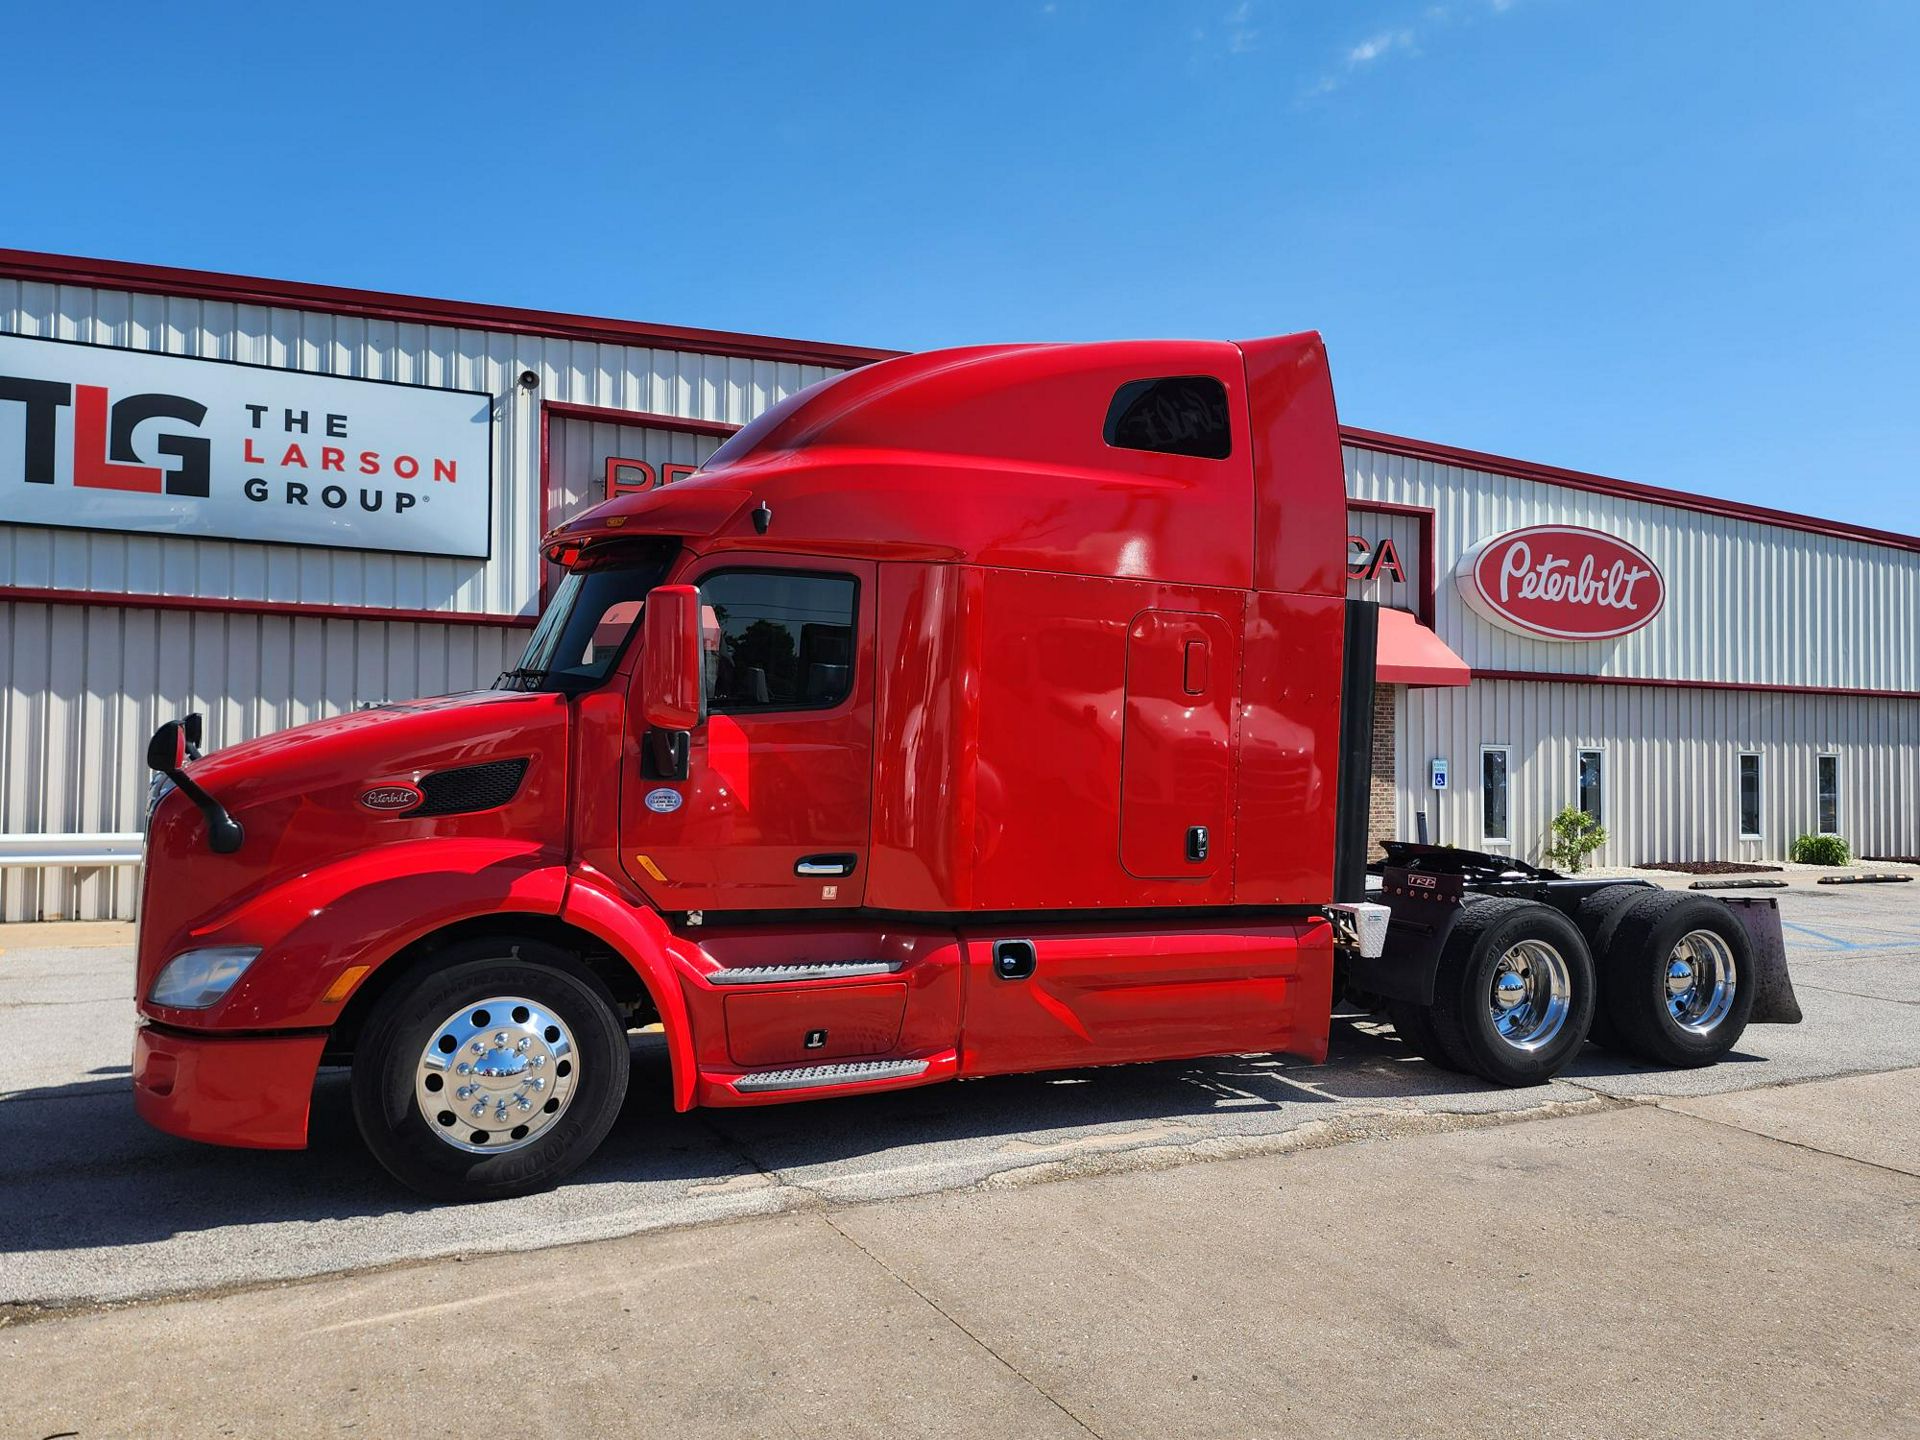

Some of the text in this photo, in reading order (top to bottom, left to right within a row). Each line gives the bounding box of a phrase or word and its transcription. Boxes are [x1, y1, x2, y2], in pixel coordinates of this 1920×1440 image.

[0, 375, 211, 498] TLG
[245, 404, 347, 438] THE
[244, 438, 457, 483] LARSON
[1500, 541, 1650, 610] Peterbilt
[368, 792, 412, 805] Peterbilt
